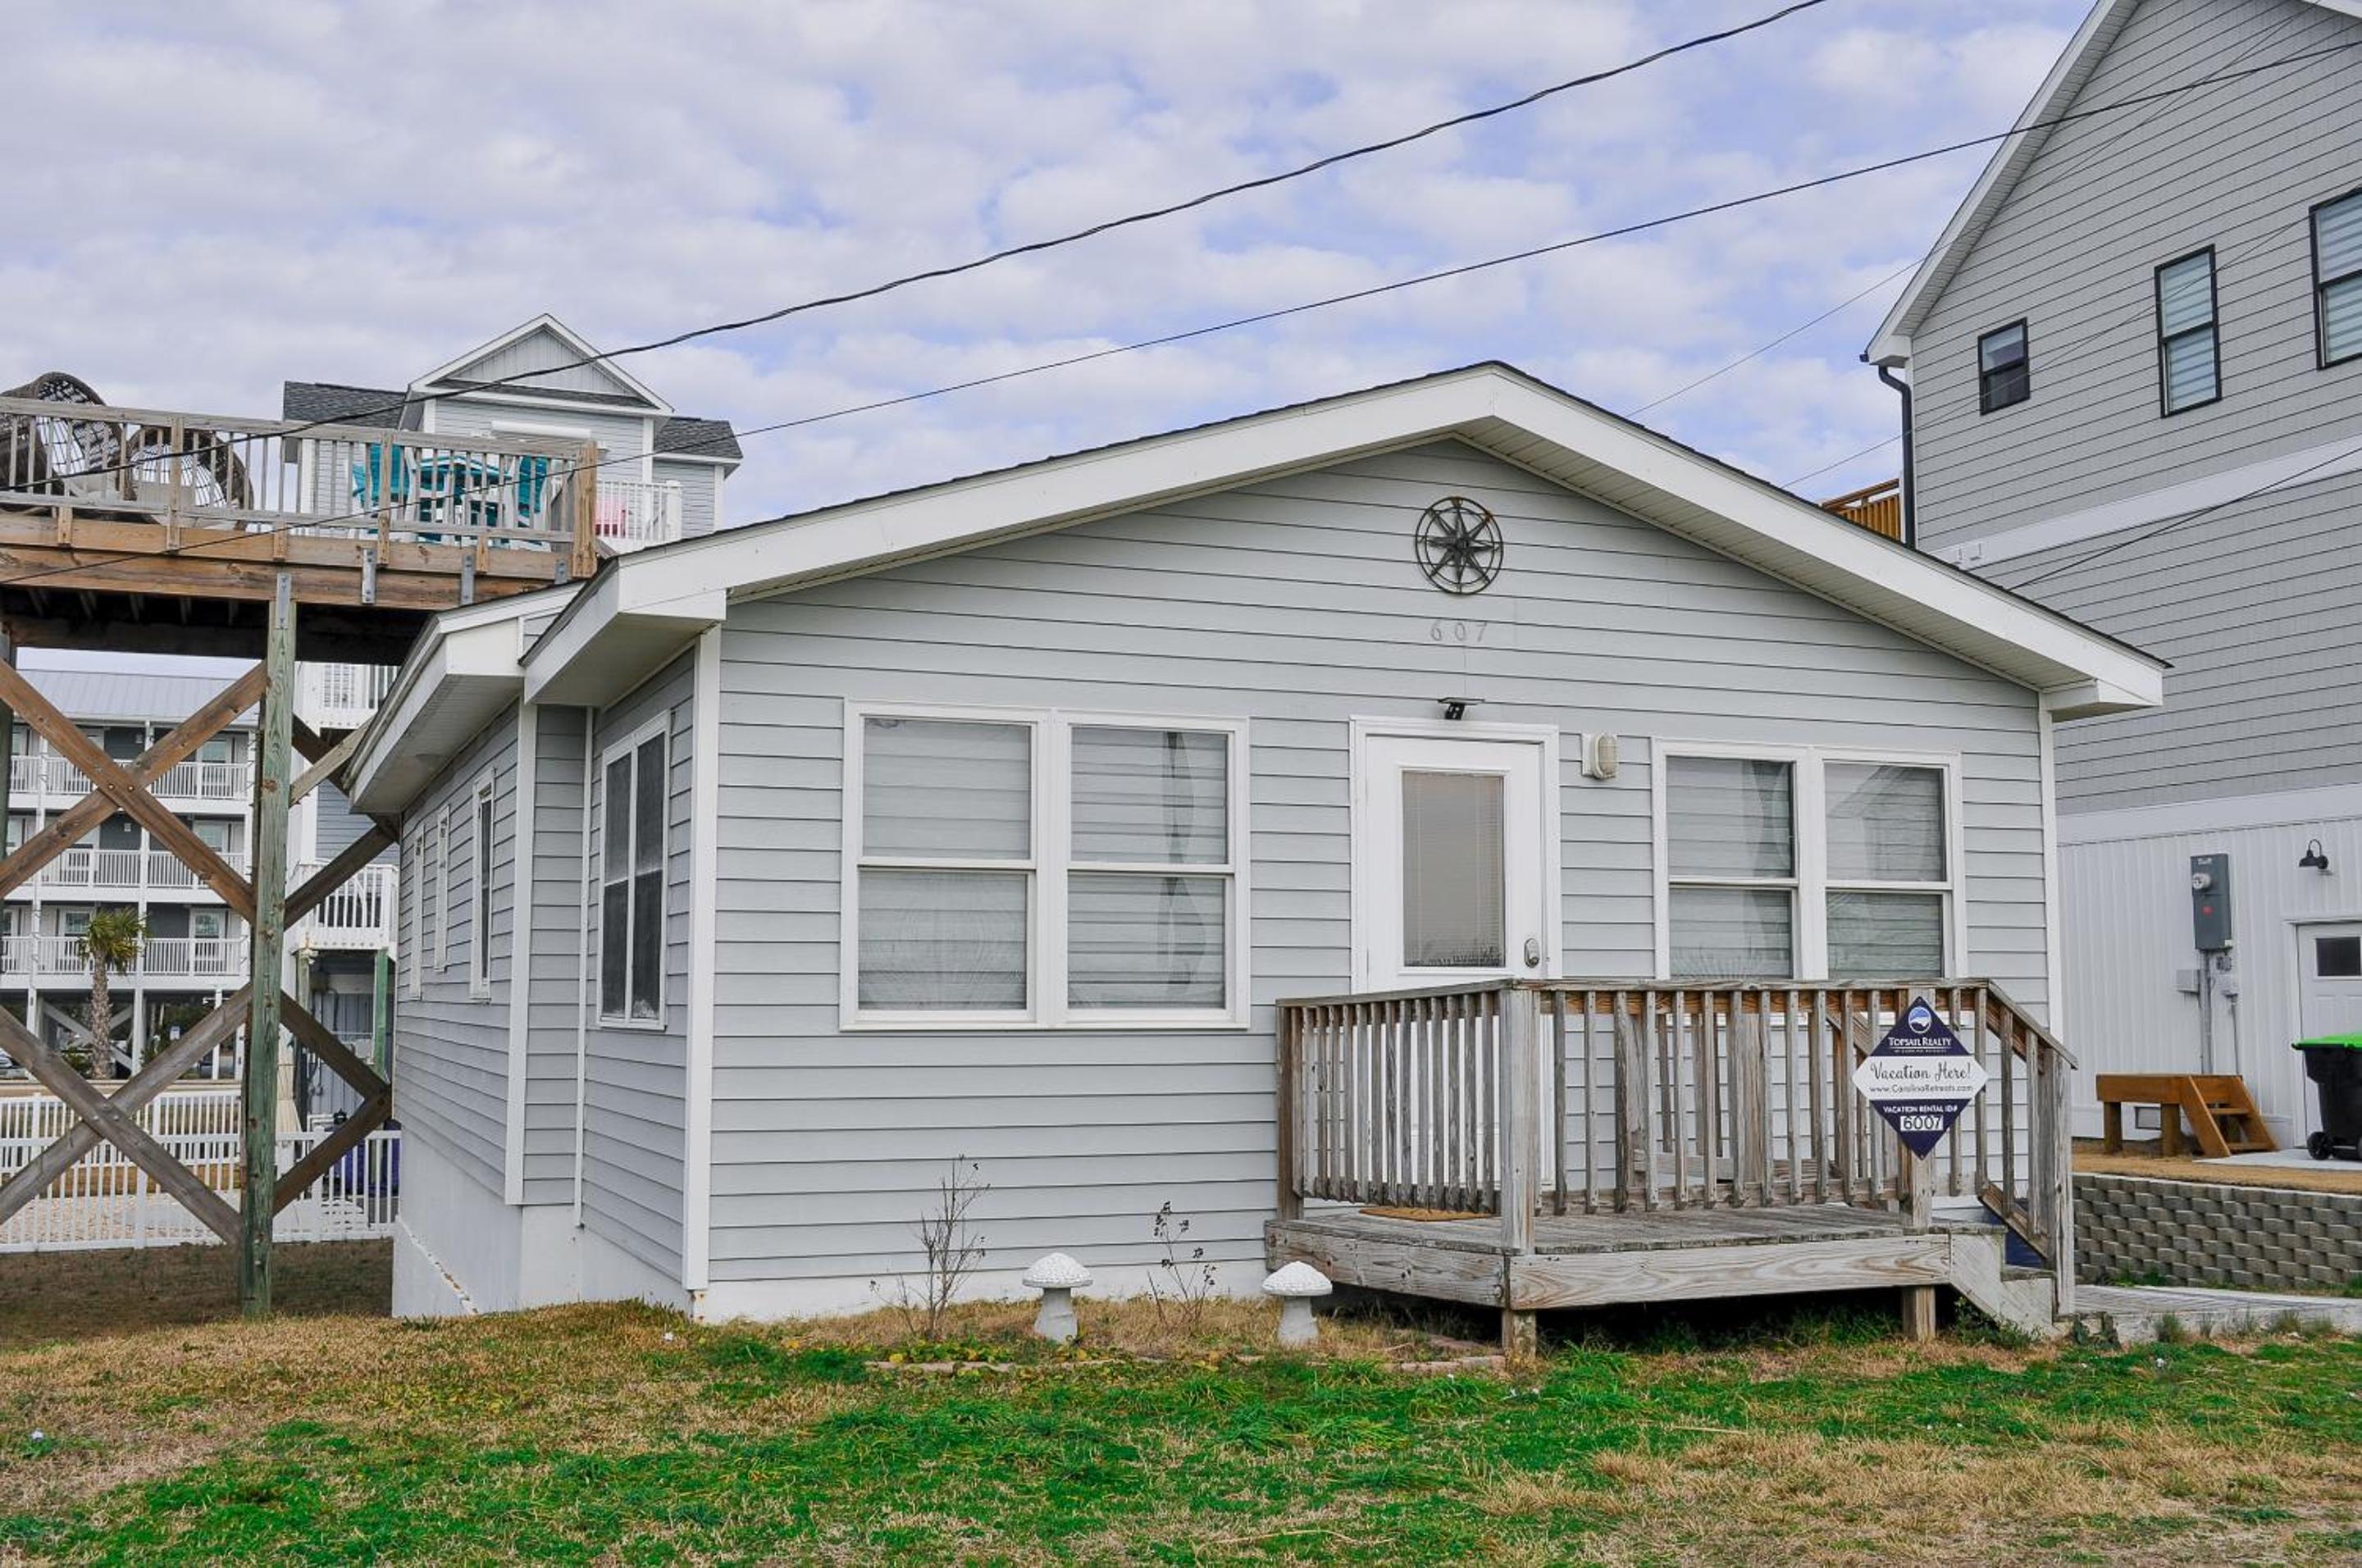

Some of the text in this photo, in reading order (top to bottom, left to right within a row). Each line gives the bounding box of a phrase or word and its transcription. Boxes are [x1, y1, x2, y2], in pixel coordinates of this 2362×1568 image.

[1430, 619, 1488, 643] 607
[1922, 1037, 1952, 1046] REALTY
[1870, 1060, 1972, 1082] Vacation Here!
[1883, 1105, 1917, 1114] VACATION
[1903, 1115, 1941, 1129] 6007
